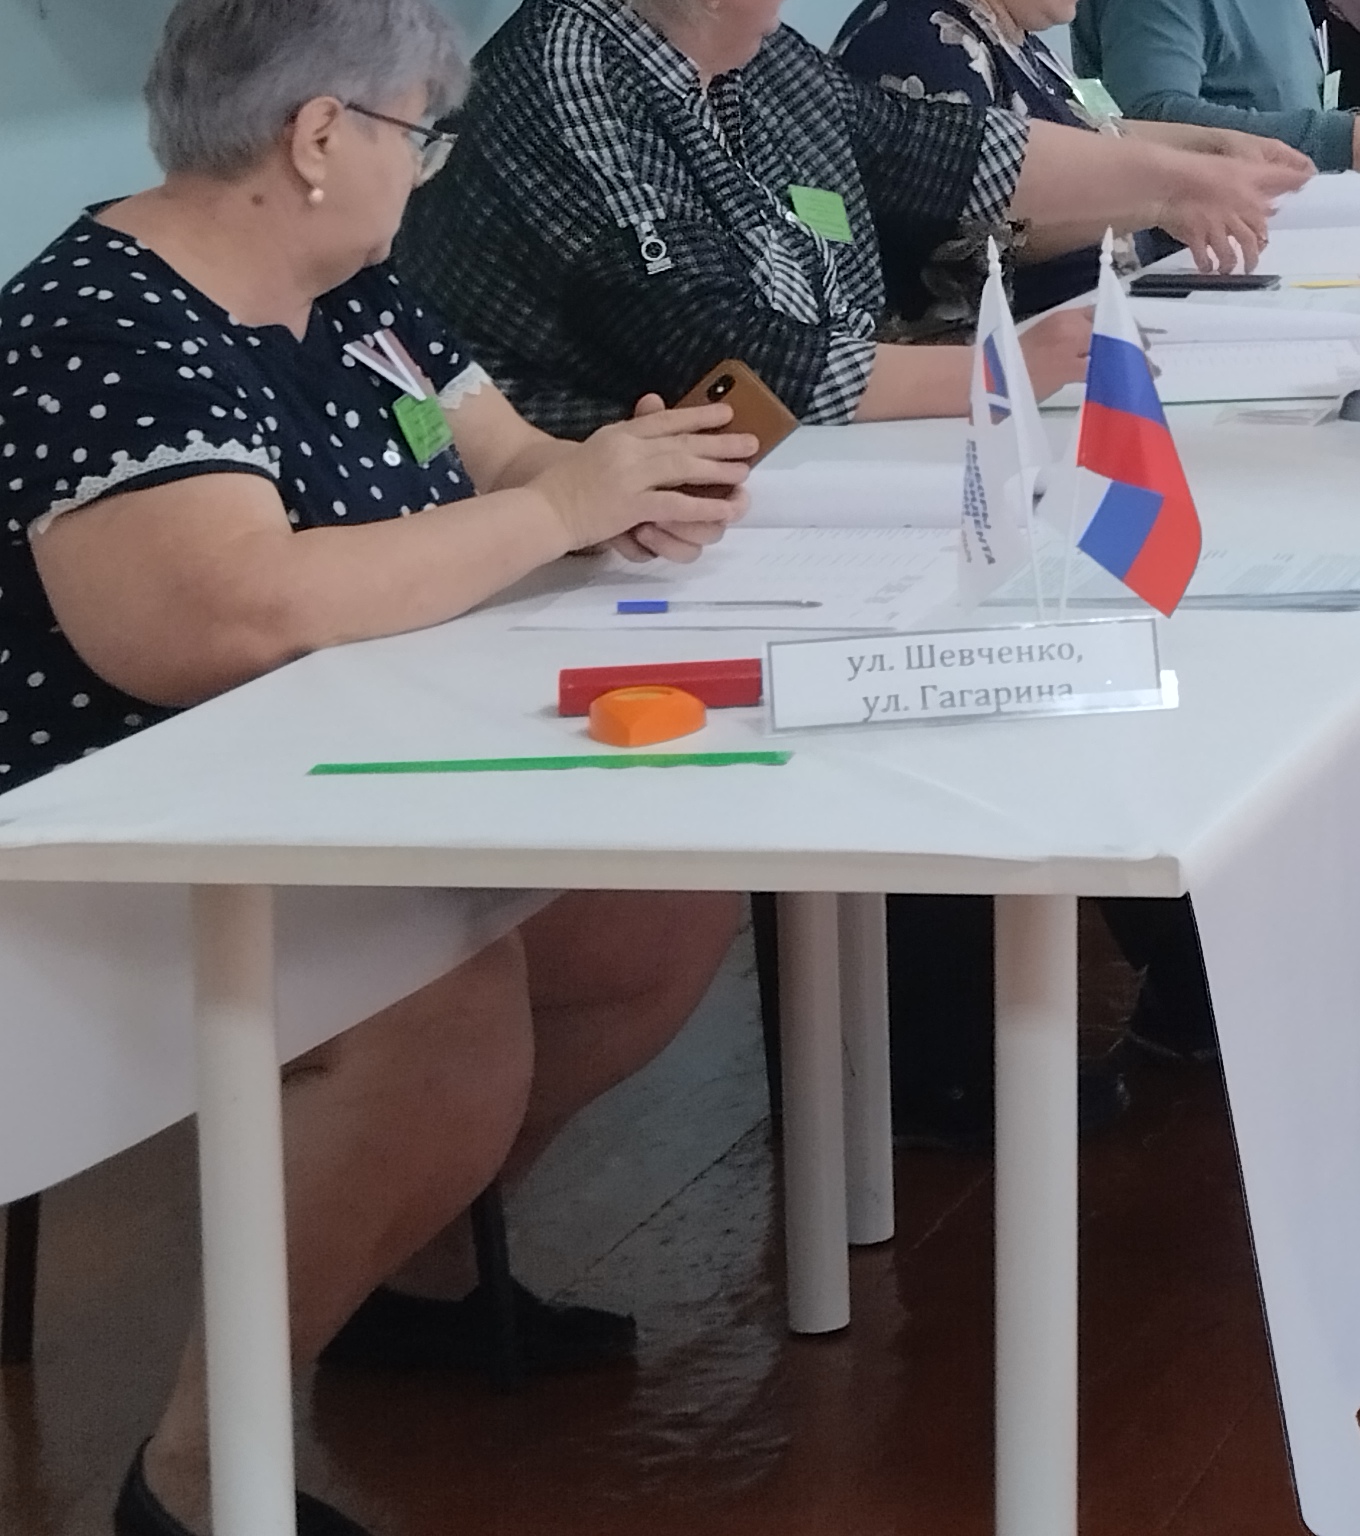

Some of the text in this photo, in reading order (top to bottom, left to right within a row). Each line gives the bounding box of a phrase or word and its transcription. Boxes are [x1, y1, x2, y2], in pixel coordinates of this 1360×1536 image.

[846, 642, 1084, 682] ул. Шевченко,
[862, 682, 1073, 722] ул. Гагарина
